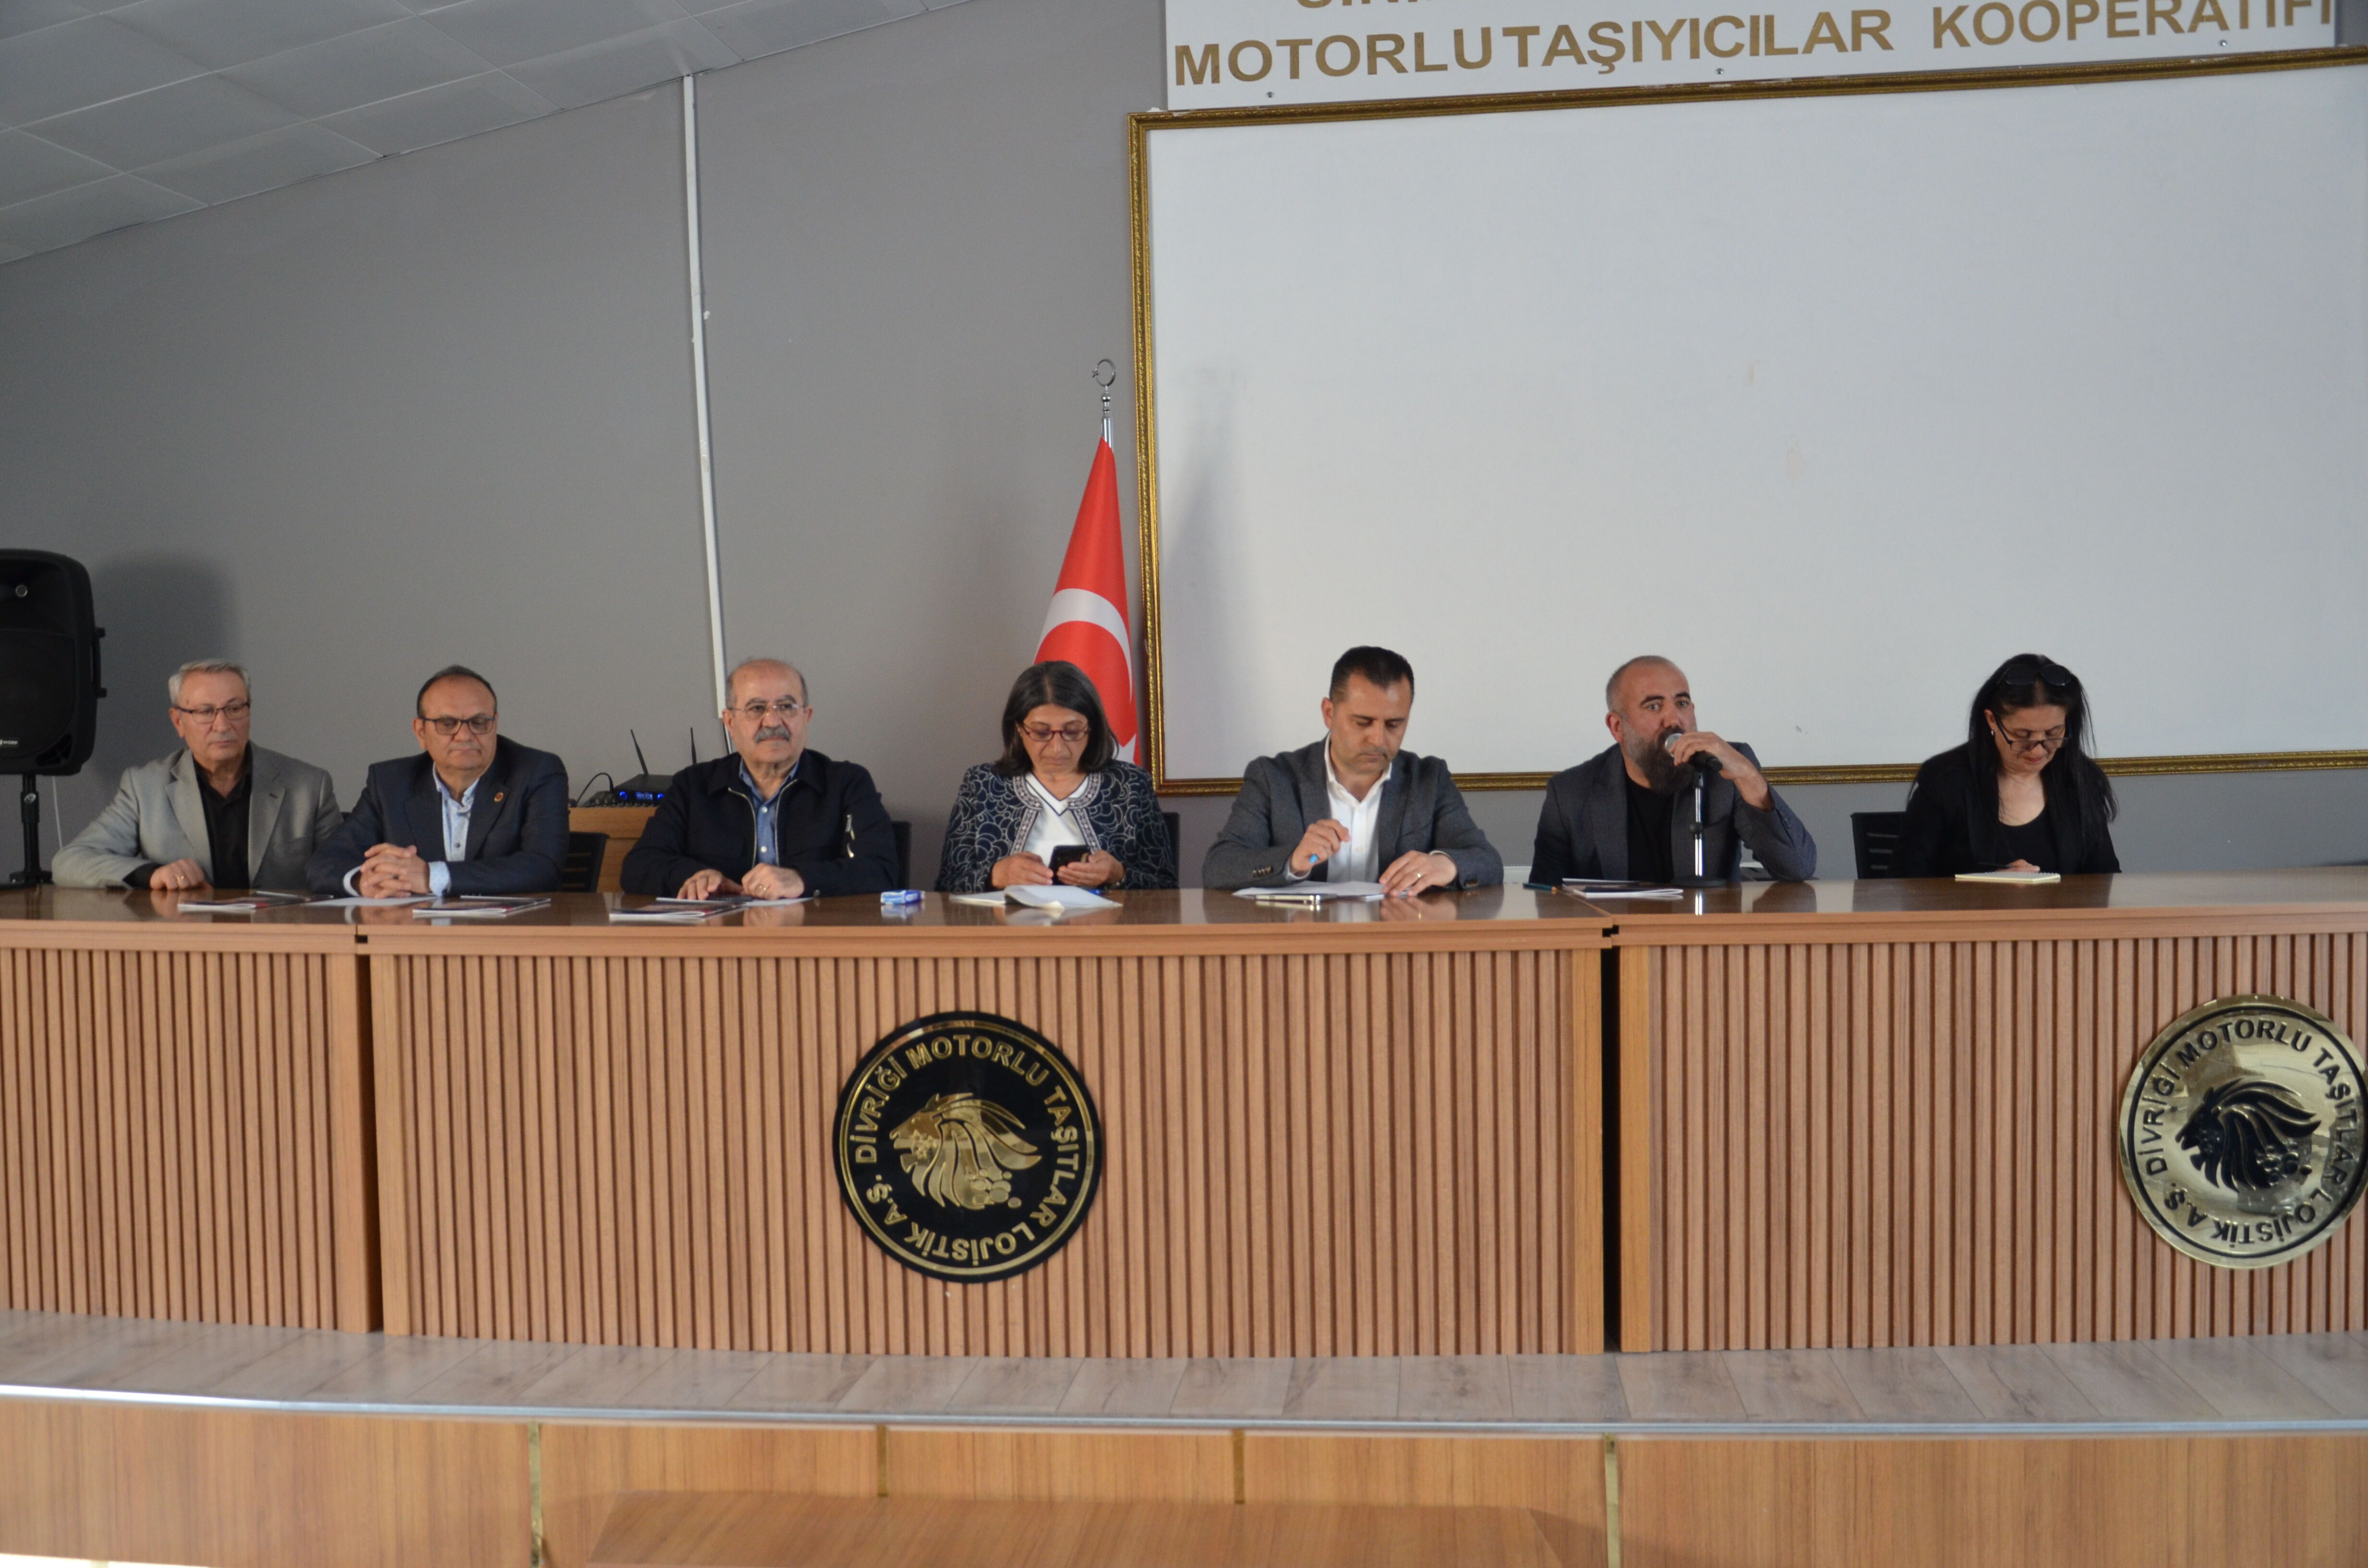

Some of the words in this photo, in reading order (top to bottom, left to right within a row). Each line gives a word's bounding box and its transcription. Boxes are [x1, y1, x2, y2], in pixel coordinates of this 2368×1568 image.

[905, 1034, 1049, 1087] MOTORLU
[2176, 1018, 2312, 1069] MOTORLU
[2313, 1047, 2358, 1187] TAŞITLAR
[1030, 1085, 1079, 1227] TAŞITLAR
[904, 1222, 1035, 1266] LOJİSTİK
